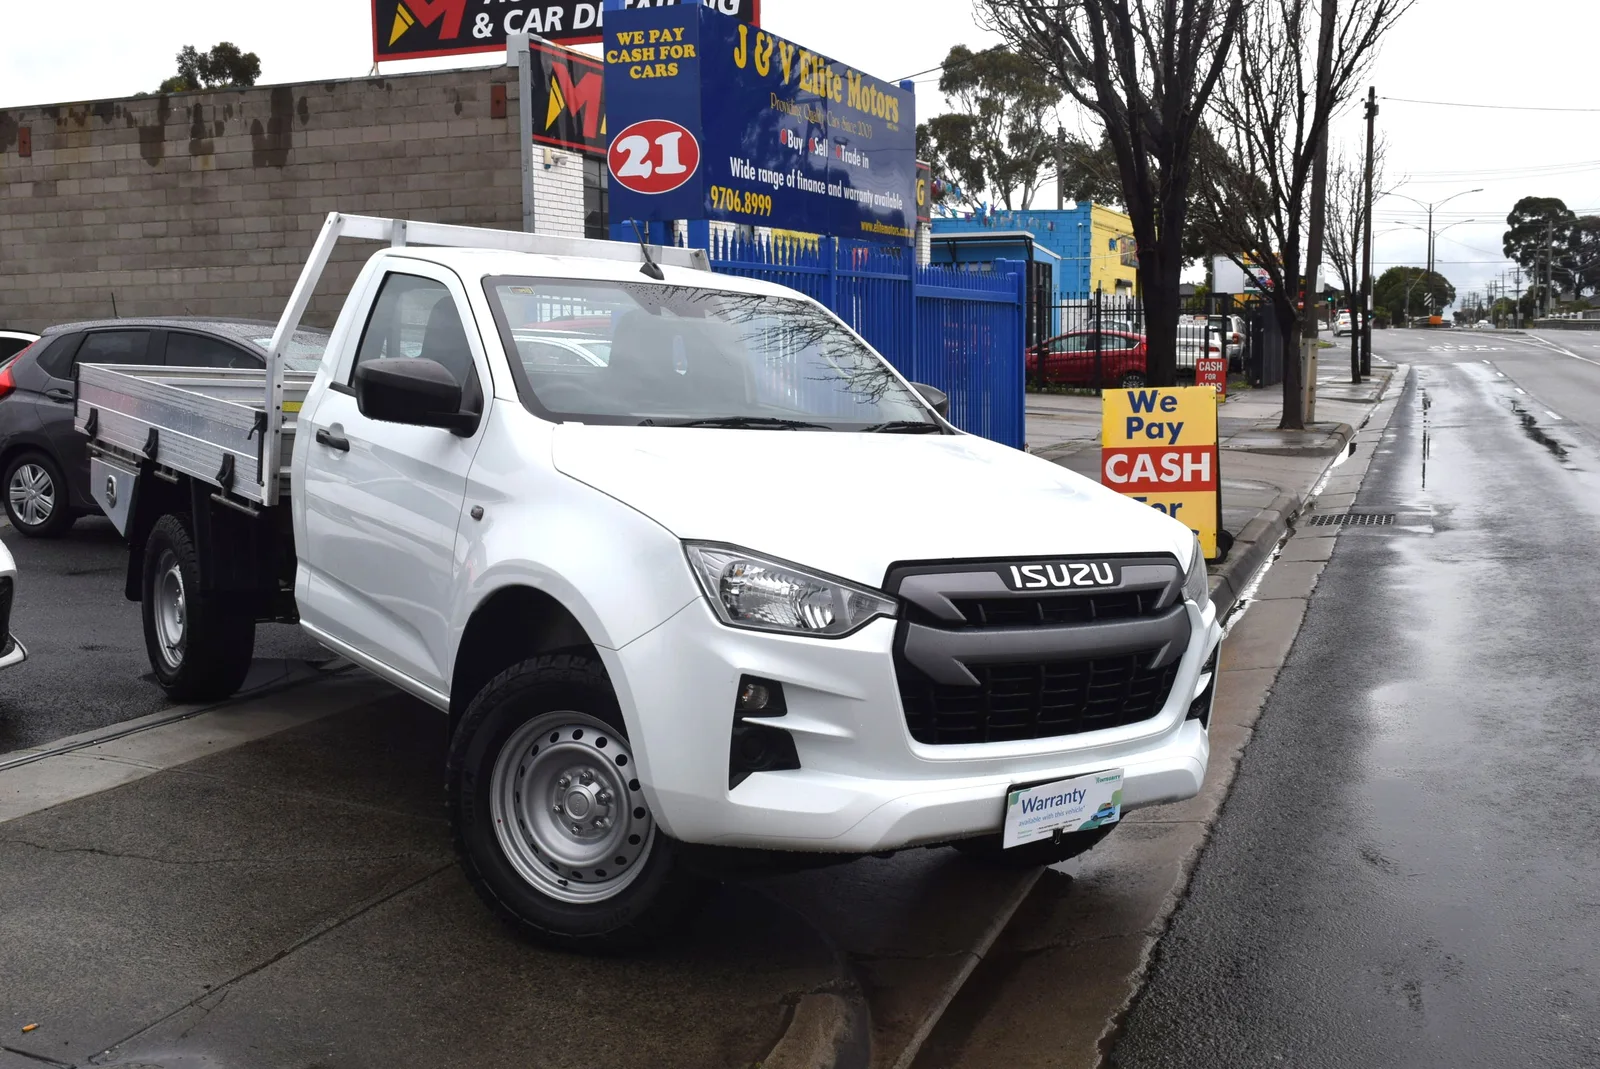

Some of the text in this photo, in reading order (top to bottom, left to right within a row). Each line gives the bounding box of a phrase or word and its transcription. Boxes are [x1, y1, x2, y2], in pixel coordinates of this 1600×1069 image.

[472, 12, 494, 39] &
[503, 6, 565, 36] CAR
[616, 27, 685, 46] WE PAY
[606, 44, 697, 64] CASH FOR
[629, 62, 679, 79] CARS
[733, 23, 899, 123] J & V Elite Motors
[770, 91, 802, 124] Providing
[616, 131, 687, 179] 21
[787, 129, 869, 169] Buy Sell Trade in
[729, 156, 903, 210] Wide range of finance and warranty available
[710, 185, 772, 217] 9706.8999
[1198, 361, 1223, 371] CASH
[1127, 389, 1178, 413] We
[1126, 416, 1184, 445] Pay
[1105, 452, 1211, 484] CASH
[1010, 562, 1114, 588] ISUZU
[1021, 788, 1087, 814] Warranty
